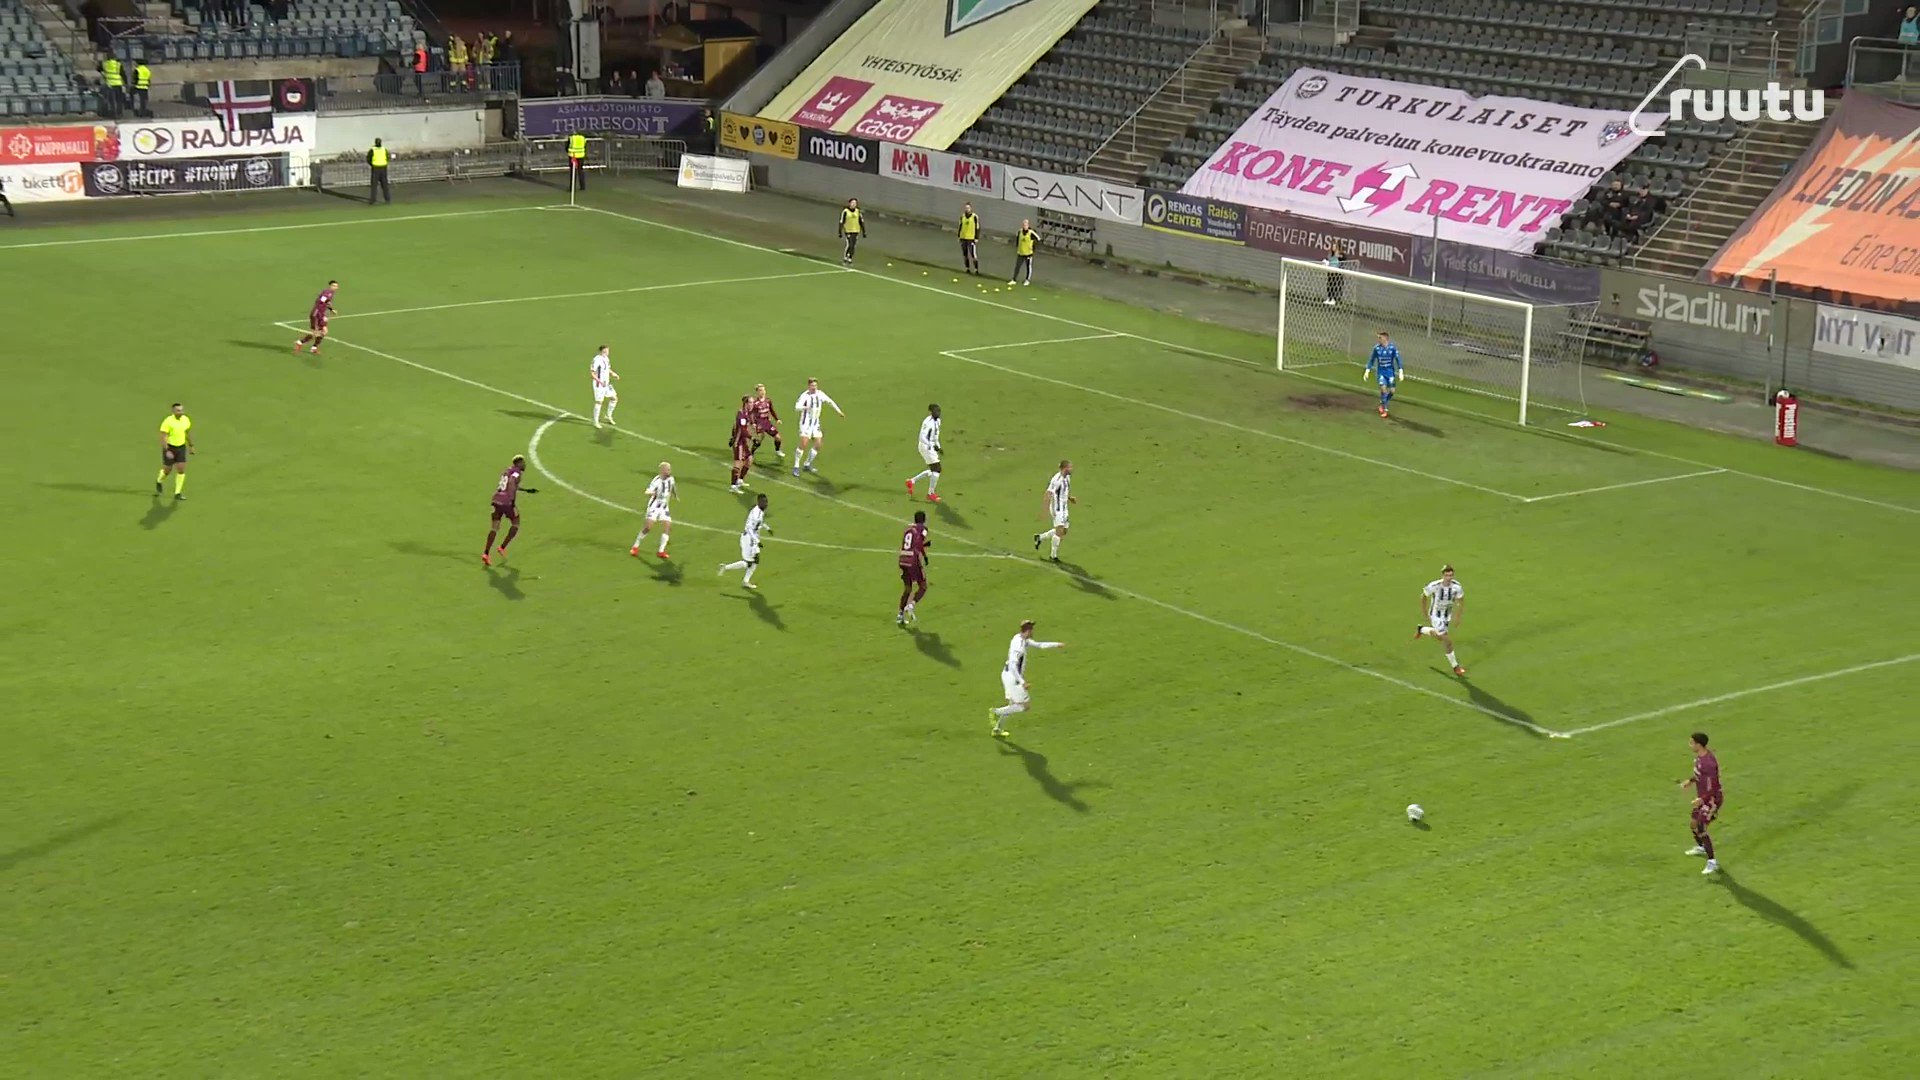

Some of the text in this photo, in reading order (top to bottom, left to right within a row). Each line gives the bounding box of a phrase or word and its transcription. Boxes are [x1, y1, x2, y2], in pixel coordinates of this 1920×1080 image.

[861, 55, 962, 83] YHTEISTYÖSSÄ:
[558, 103, 662, 114] ASIANAJOTOIMISTO
[1335, 86, 1587, 137] TURKULAISET
[552, 116, 650, 132] THURESON
[856, 118, 913, 140] casco
[182, 125, 304, 149] RAJUPAJA
[810, 136, 867, 163] mauno
[1262, 108, 1605, 178] Täyden palvelun konevuokraamo
[892, 148, 929, 178] M&M
[954, 159, 992, 189] M&M
[127, 168, 176, 186] #FCTPS
[1208, 142, 1572, 233] KONE RENT
[1013, 176, 1135, 216] GANT
[1792, 165, 1909, 215] LIEDON
[1167, 213, 1203, 228] CENTER
[1168, 200, 1203, 216] RENGAS
[1208, 204, 1239, 221] Raisio
[1359, 241, 1393, 262] PUMA
[1818, 315, 1859, 347] NYT
[903, 532, 913, 550] 9
